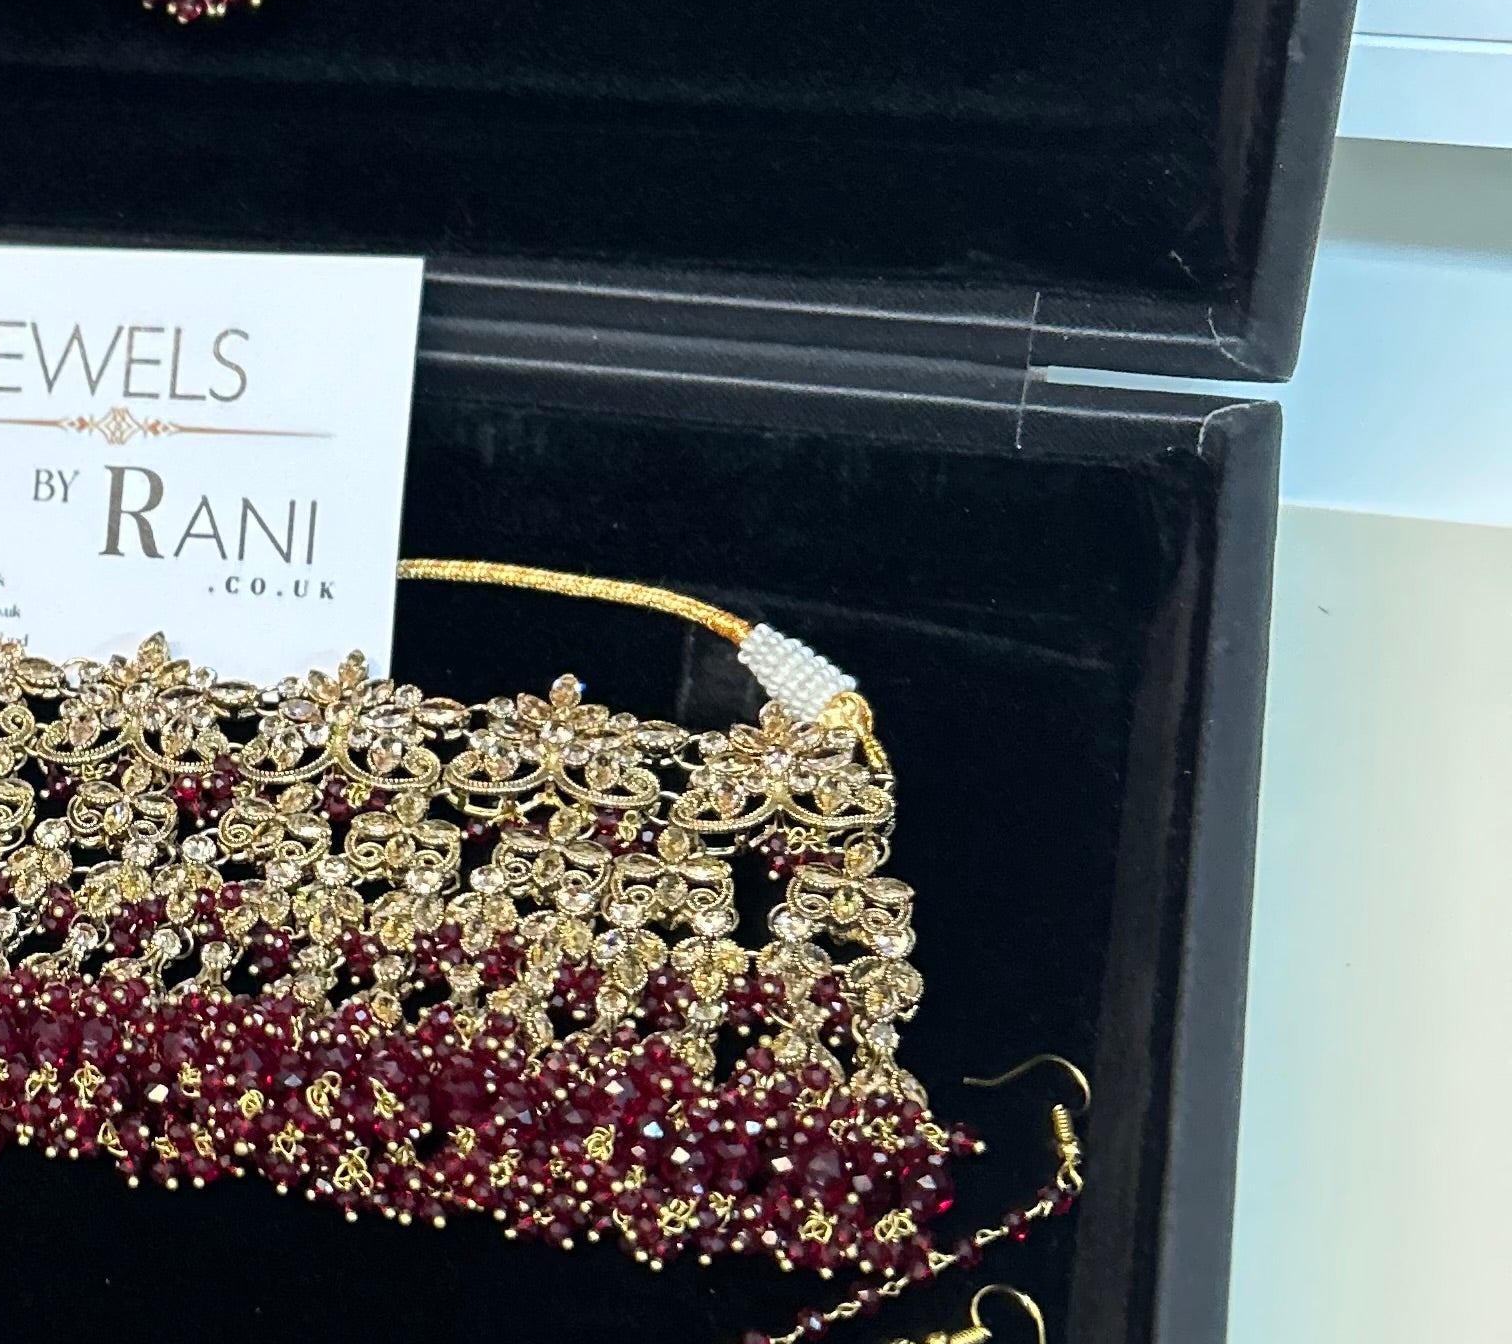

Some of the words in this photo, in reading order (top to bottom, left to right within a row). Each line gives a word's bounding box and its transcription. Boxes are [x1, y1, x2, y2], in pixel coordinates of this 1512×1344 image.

[32, 468, 80, 504] BY
[98, 465, 320, 566] RANI
[207, 574, 336, 601] .CO.UK
